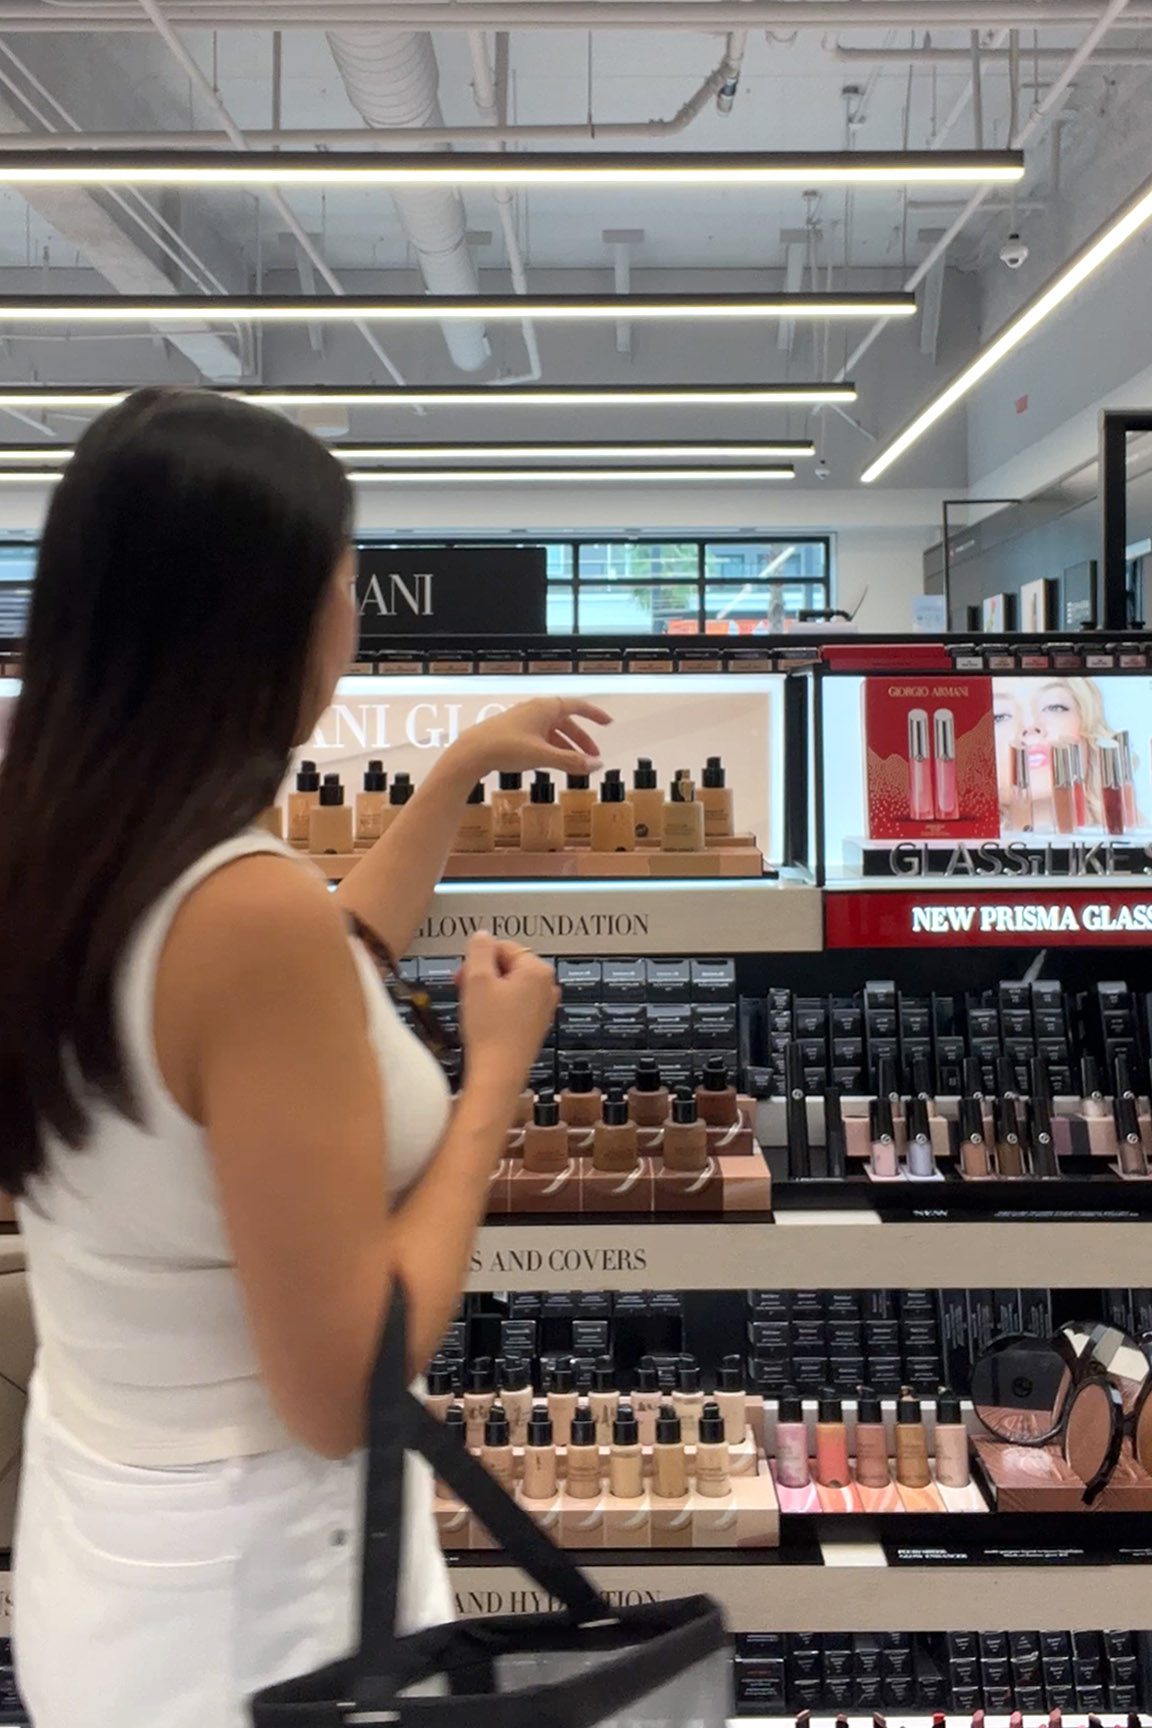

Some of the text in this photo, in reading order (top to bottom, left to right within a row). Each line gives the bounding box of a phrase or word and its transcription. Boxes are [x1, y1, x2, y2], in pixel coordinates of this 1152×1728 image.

[888, 686, 968, 697] GIORGIO ARMANI
[492, 913, 649, 937] FOUNDATION
[912, 906, 975, 932] NEW
[980, 905, 1079, 932] PRISMA
[490, 1250, 542, 1272] AND
[549, 1249, 647, 1271] COVERS
[454, 1589, 661, 1613] AND HYDTION
